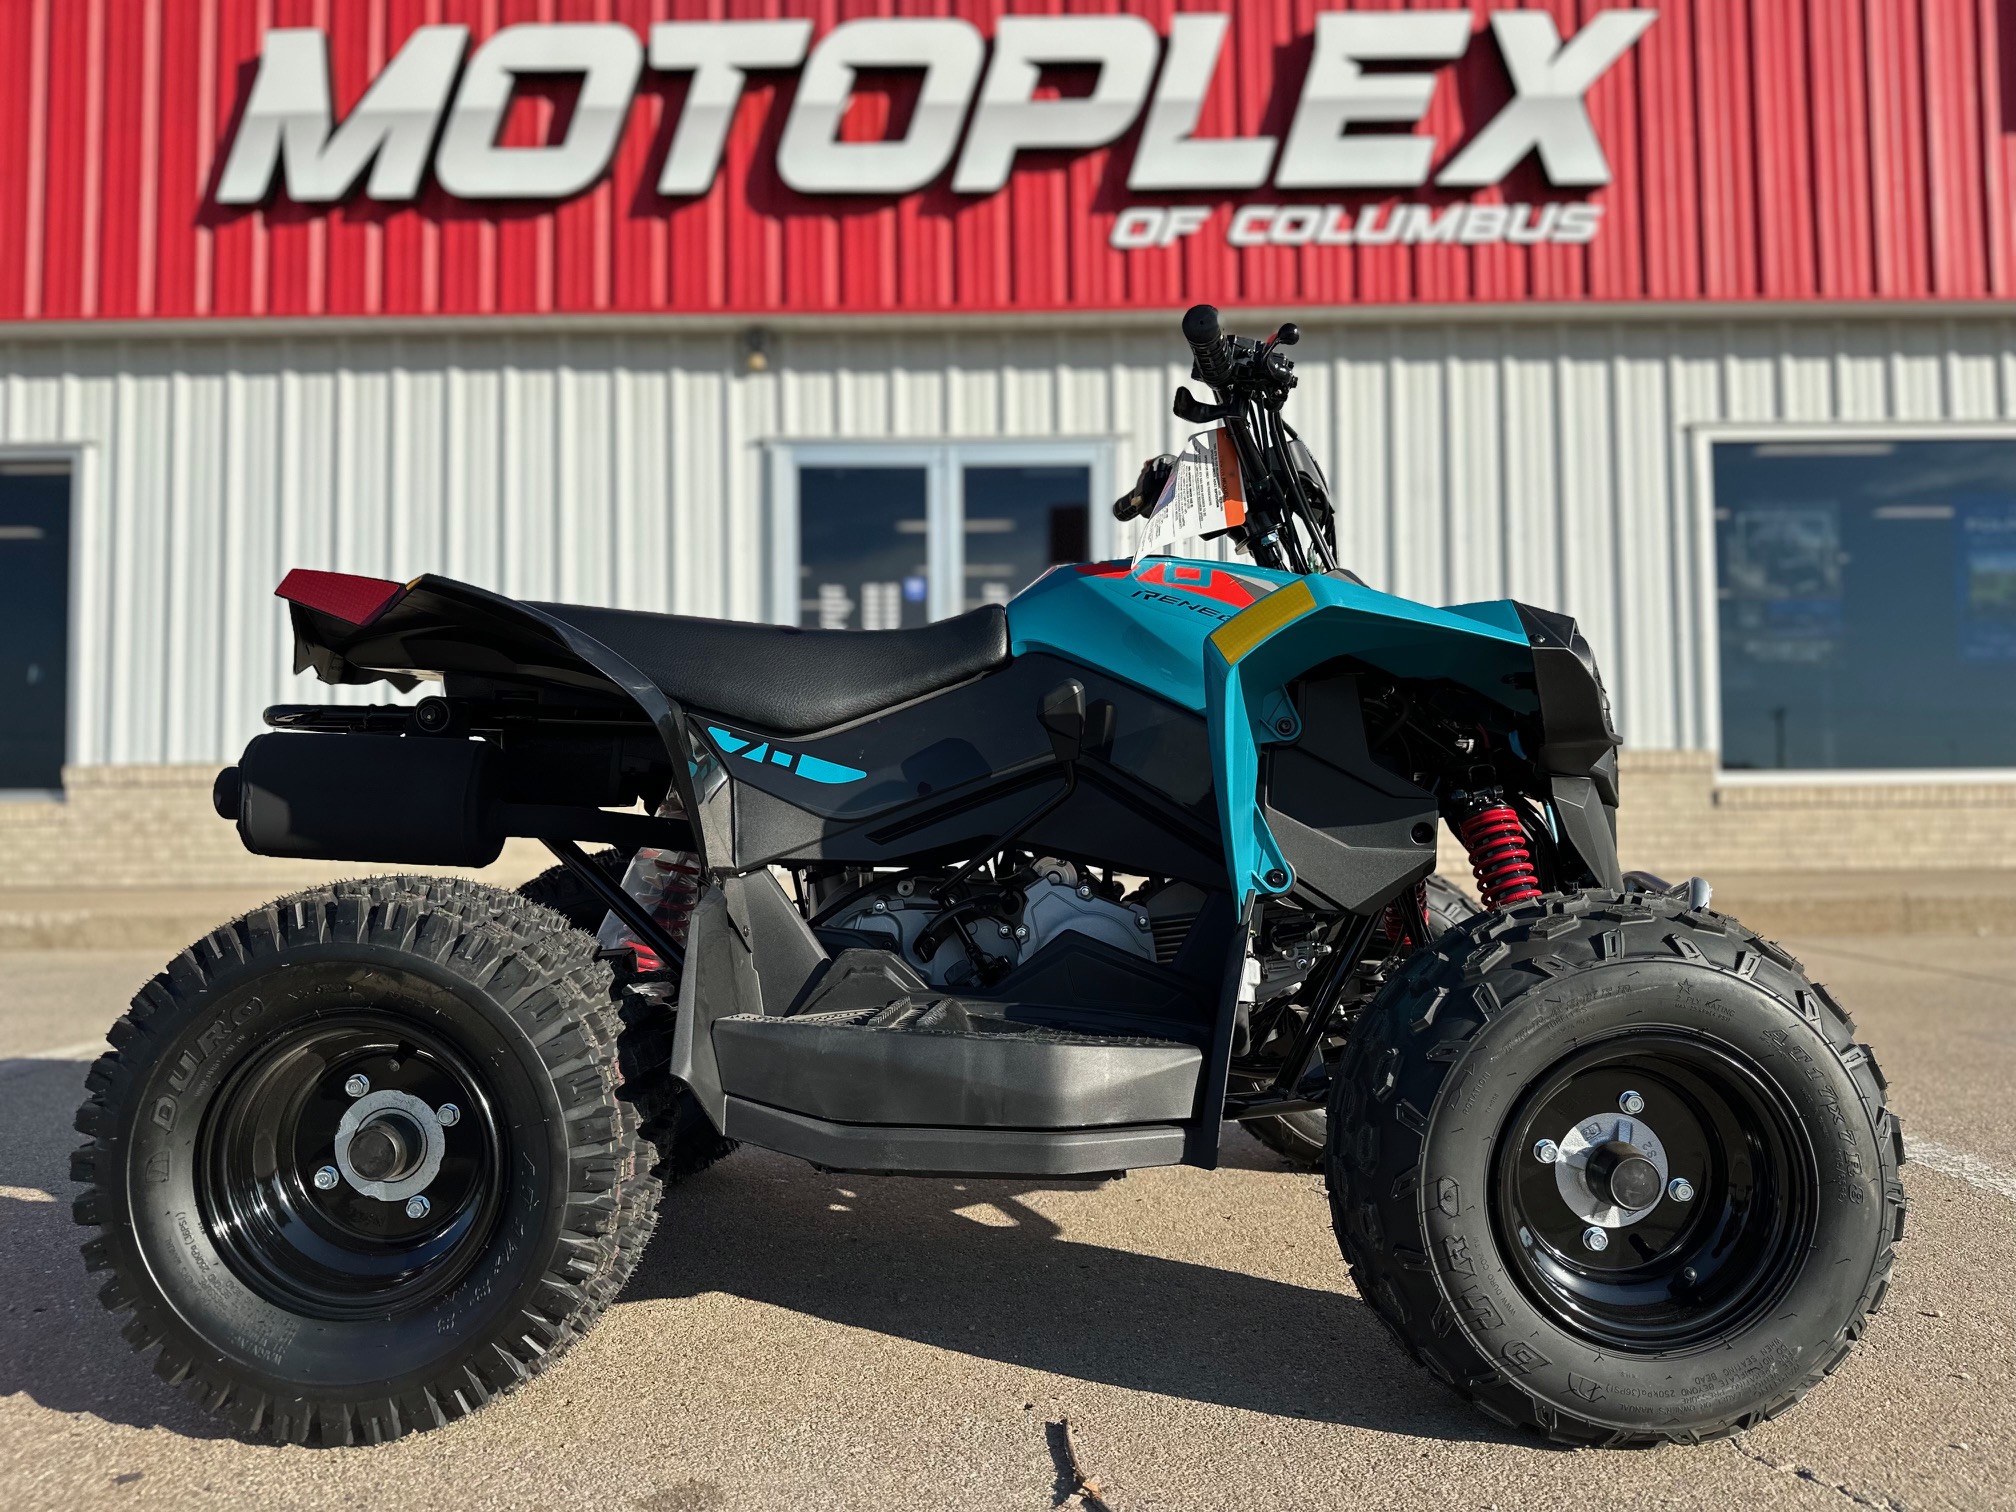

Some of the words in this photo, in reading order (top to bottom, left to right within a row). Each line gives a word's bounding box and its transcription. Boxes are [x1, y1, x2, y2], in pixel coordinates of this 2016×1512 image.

[215, 9, 1658, 204] MOTOPLEX
[1109, 206, 1209, 249] OF
[1227, 202, 1604, 246] COLUMBUS
[148, 991, 266, 1131] DURO
[1461, 1069, 1491, 1116] ROTATION
[206, 1272, 232, 1300] BEYOND
[1759, 1336, 1782, 1356] WHEN
[1722, 1353, 1757, 1377] SEATING
[1757, 1353, 1775, 1368] NOT
[1679, 1381, 1714, 1397] BEYOND
[1618, 1403, 1654, 1413] MANUAL
